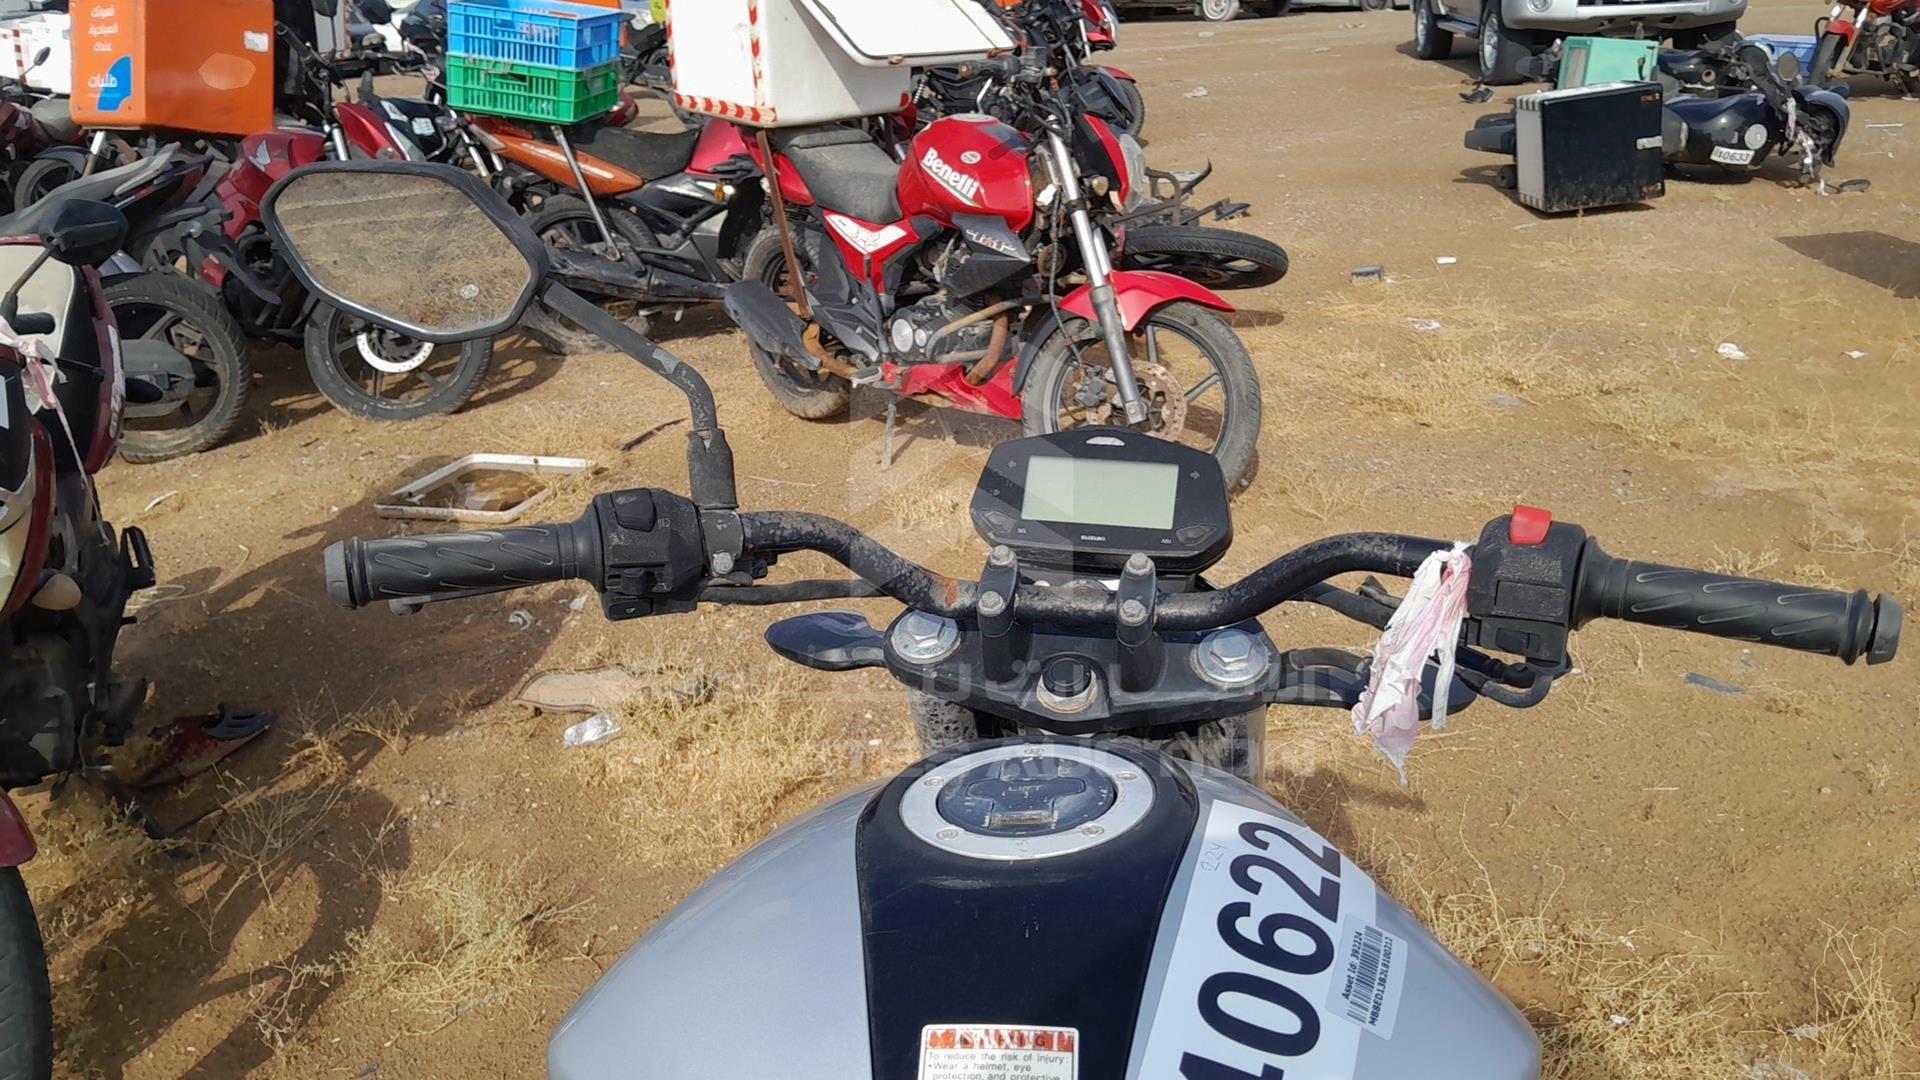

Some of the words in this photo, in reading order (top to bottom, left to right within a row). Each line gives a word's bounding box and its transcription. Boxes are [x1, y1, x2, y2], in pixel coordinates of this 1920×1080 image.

[88, 73, 118, 88] طلبات
[921, 147, 980, 200] Benelli
[1080, 534, 1106, 542] SUZUKI
[1341, 972, 1356, 1001] Asset
[1350, 930, 1362, 961] 392224
[944, 1052, 976, 1061] reduce
[1001, 1053, 1019, 1062] risk
[1023, 1053, 1033, 1062] of
[974, 1061, 1010, 1072] helmet,
[1014, 1064, 1032, 1073] eye
[988, 1072, 1006, 1080] and
